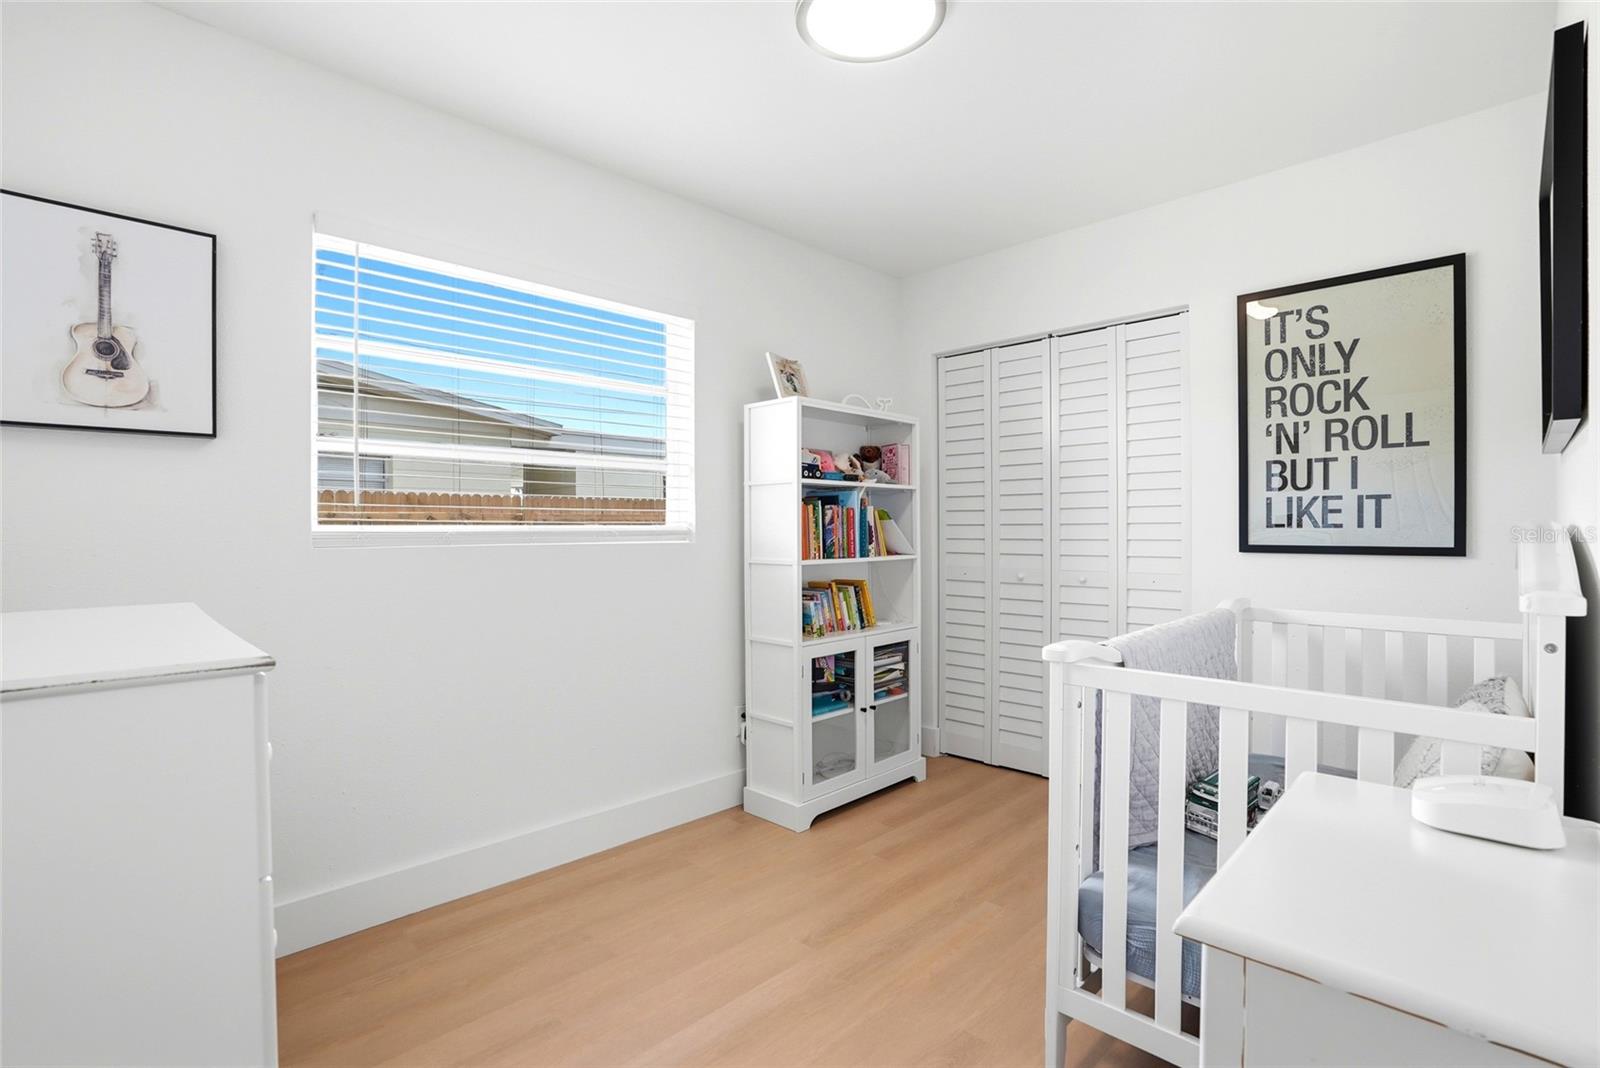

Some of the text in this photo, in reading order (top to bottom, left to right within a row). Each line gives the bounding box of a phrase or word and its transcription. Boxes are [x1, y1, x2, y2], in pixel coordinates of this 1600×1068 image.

[1264, 304, 1330, 346] IT'S
[1265, 338, 1360, 382] ONLY
[1265, 376, 1370, 419] ROCK
[1265, 412, 1430, 455] 'N' ROLL
[1266, 455, 1358, 492] BUT I
[1266, 494, 1391, 529] LIKE IT
